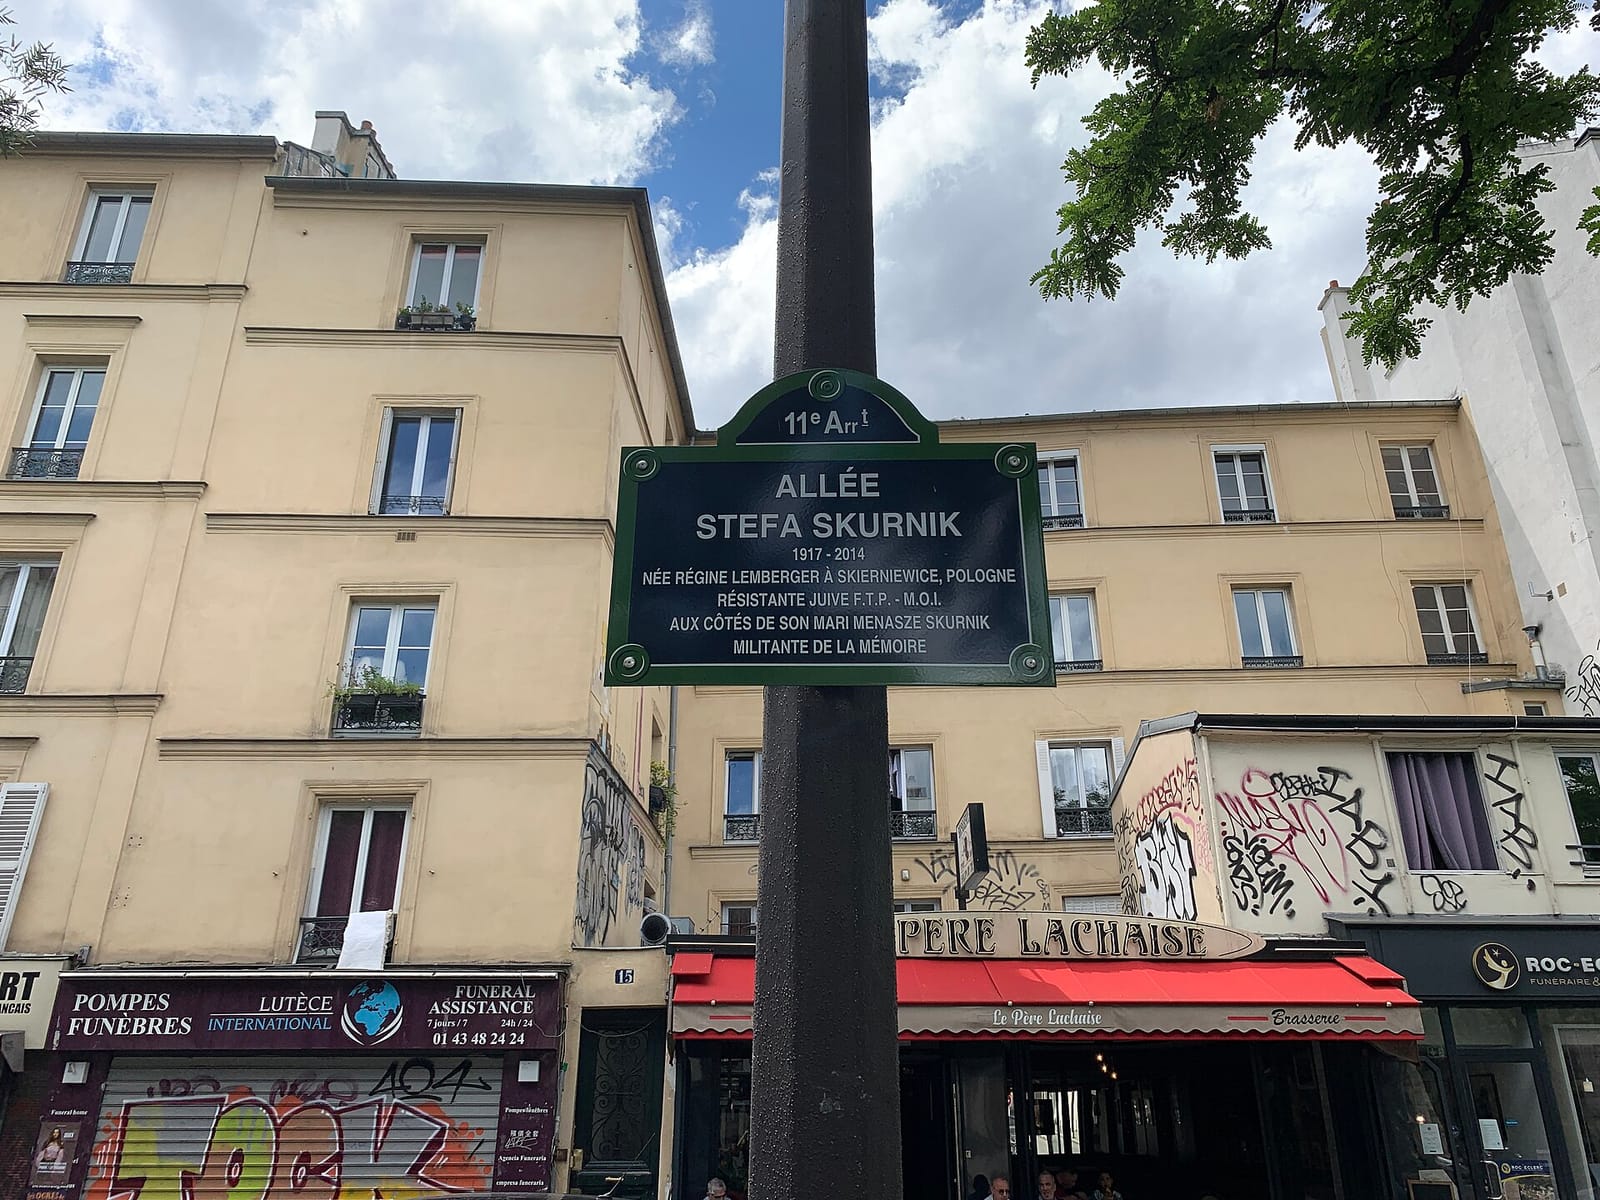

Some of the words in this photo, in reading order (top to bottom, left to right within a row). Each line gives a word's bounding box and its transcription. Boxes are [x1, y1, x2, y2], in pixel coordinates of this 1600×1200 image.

[784, 411, 821, 435] 11e
[775, 466, 881, 499] ALLÉE
[696, 513, 802, 540] STEFA
[812, 511, 962, 540] SKURNIK
[792, 547, 823, 561] 1917
[834, 547, 865, 561] 2014
[642, 567, 671, 585] NÉE
[675, 567, 728, 585] RÉGINE
[732, 569, 820, 585] LEMBERGER
[823, 565, 834, 584] À
[837, 568, 943, 586] SKIERNIEWICE,
[946, 568, 1017, 583] POLOGNE
[718, 589, 806, 608] RÉSISTANTE
[809, 592, 850, 607] JUIVE
[853, 592, 892, 607] F.T.P.
[903, 591, 942, 606] M.O.I.
[669, 616, 700, 631] AUX
[703, 612, 752, 631] CÔTÉS
[756, 615, 776, 630] DE
[779, 615, 810, 630] SON
[814, 615, 849, 630] MARI
[853, 615, 922, 630] MENASZE
[926, 615, 991, 630] SKURNIK
[733, 639, 809, 655] MILITANTE
[813, 639, 833, 654] DE
[837, 639, 856, 654] LA
[859, 635, 928, 654] MÉMOIRE
[897, 917, 996, 955] PERE
[1018, 916, 1207, 956] LACHAISE
[619, 969, 633, 983] 15
[0, 971, 40, 1000] RT
[455, 985, 536, 999] FUNERAL
[0, 1003, 31, 1014] NCAIS
[72, 993, 170, 1012] POMPES
[259, 992, 333, 1012] LUTÈCE
[428, 1000, 534, 1014] ASSISTANCE
[66, 1011, 193, 1036] FUNÈBRES
[207, 1017, 332, 1031] INTERNATIONAL
[427, 1019, 432, 1027] 7
[433, 1019, 456, 1029] jours
[462, 1019, 468, 1027] 7
[500, 1019, 516, 1028] 24h
[523, 1019, 533, 1028] 24
[993, 1009, 1007, 1025] Le
[1011, 1009, 1043, 1025] Père
[1048, 1008, 1102, 1025] Lachaise
[1271, 1008, 1341, 1026] Brasserie
[433, 1033, 448, 1045] 01
[451, 1033, 468, 1045] 43
[471, 1033, 487, 1045] 48
[489, 1033, 506, 1045] 24
[510, 1032, 525, 1045] 24
[499, 1154, 520, 1162] Agencia
